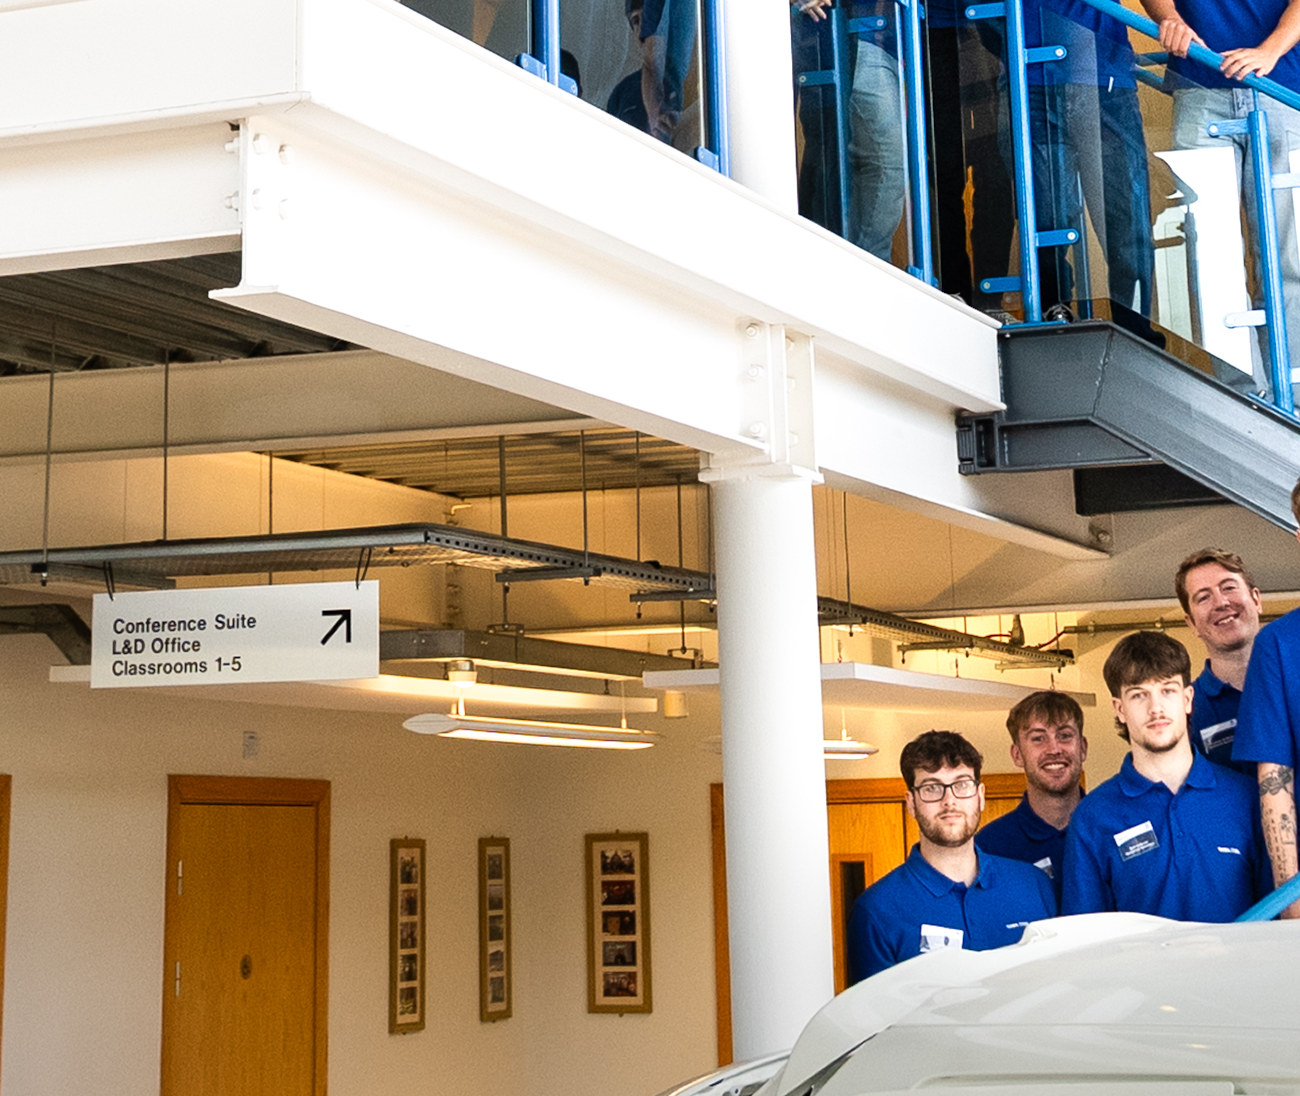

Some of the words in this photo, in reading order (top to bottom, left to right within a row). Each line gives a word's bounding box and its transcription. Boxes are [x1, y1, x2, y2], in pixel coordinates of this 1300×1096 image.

[112, 617, 207, 635] Conference
[214, 613, 257, 630] Suite
[112, 638, 146, 655] L&D
[150, 637, 202, 654] Office
[111, 660, 208, 677] Classrooms
[214, 656, 242, 673] 1-5
